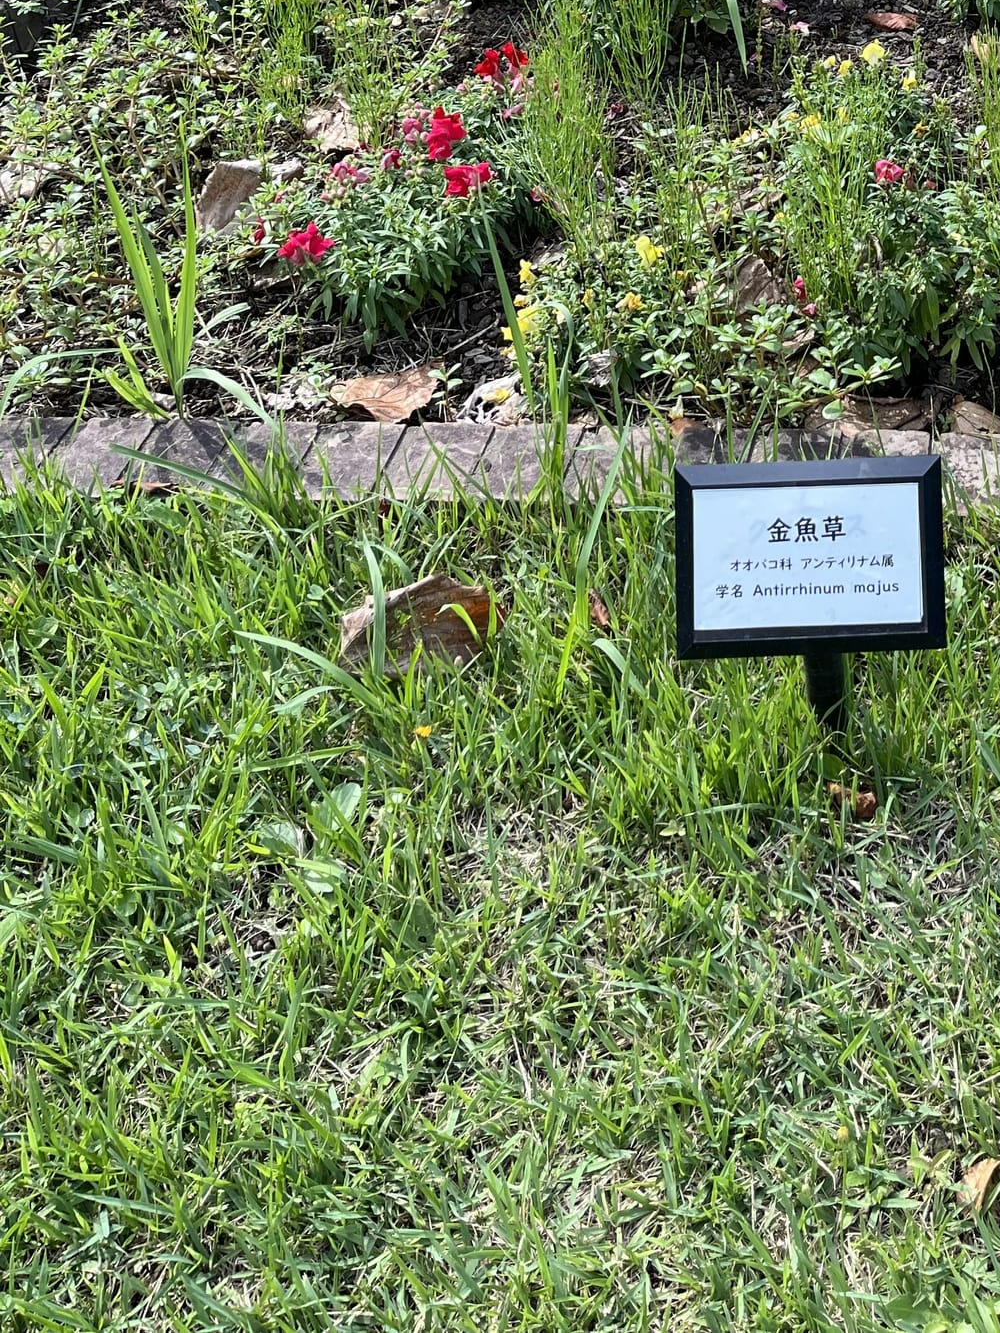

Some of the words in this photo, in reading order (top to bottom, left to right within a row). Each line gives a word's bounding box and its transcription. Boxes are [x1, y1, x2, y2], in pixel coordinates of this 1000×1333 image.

[767, 516, 846, 542] 金魚草
[731, 558, 792, 571] オオバコ科
[802, 555, 893, 569] アンティリナム属
[716, 585, 742, 598] 学名
[753, 583, 844, 596] Antirrhinum
[855, 581, 899, 595] majus
